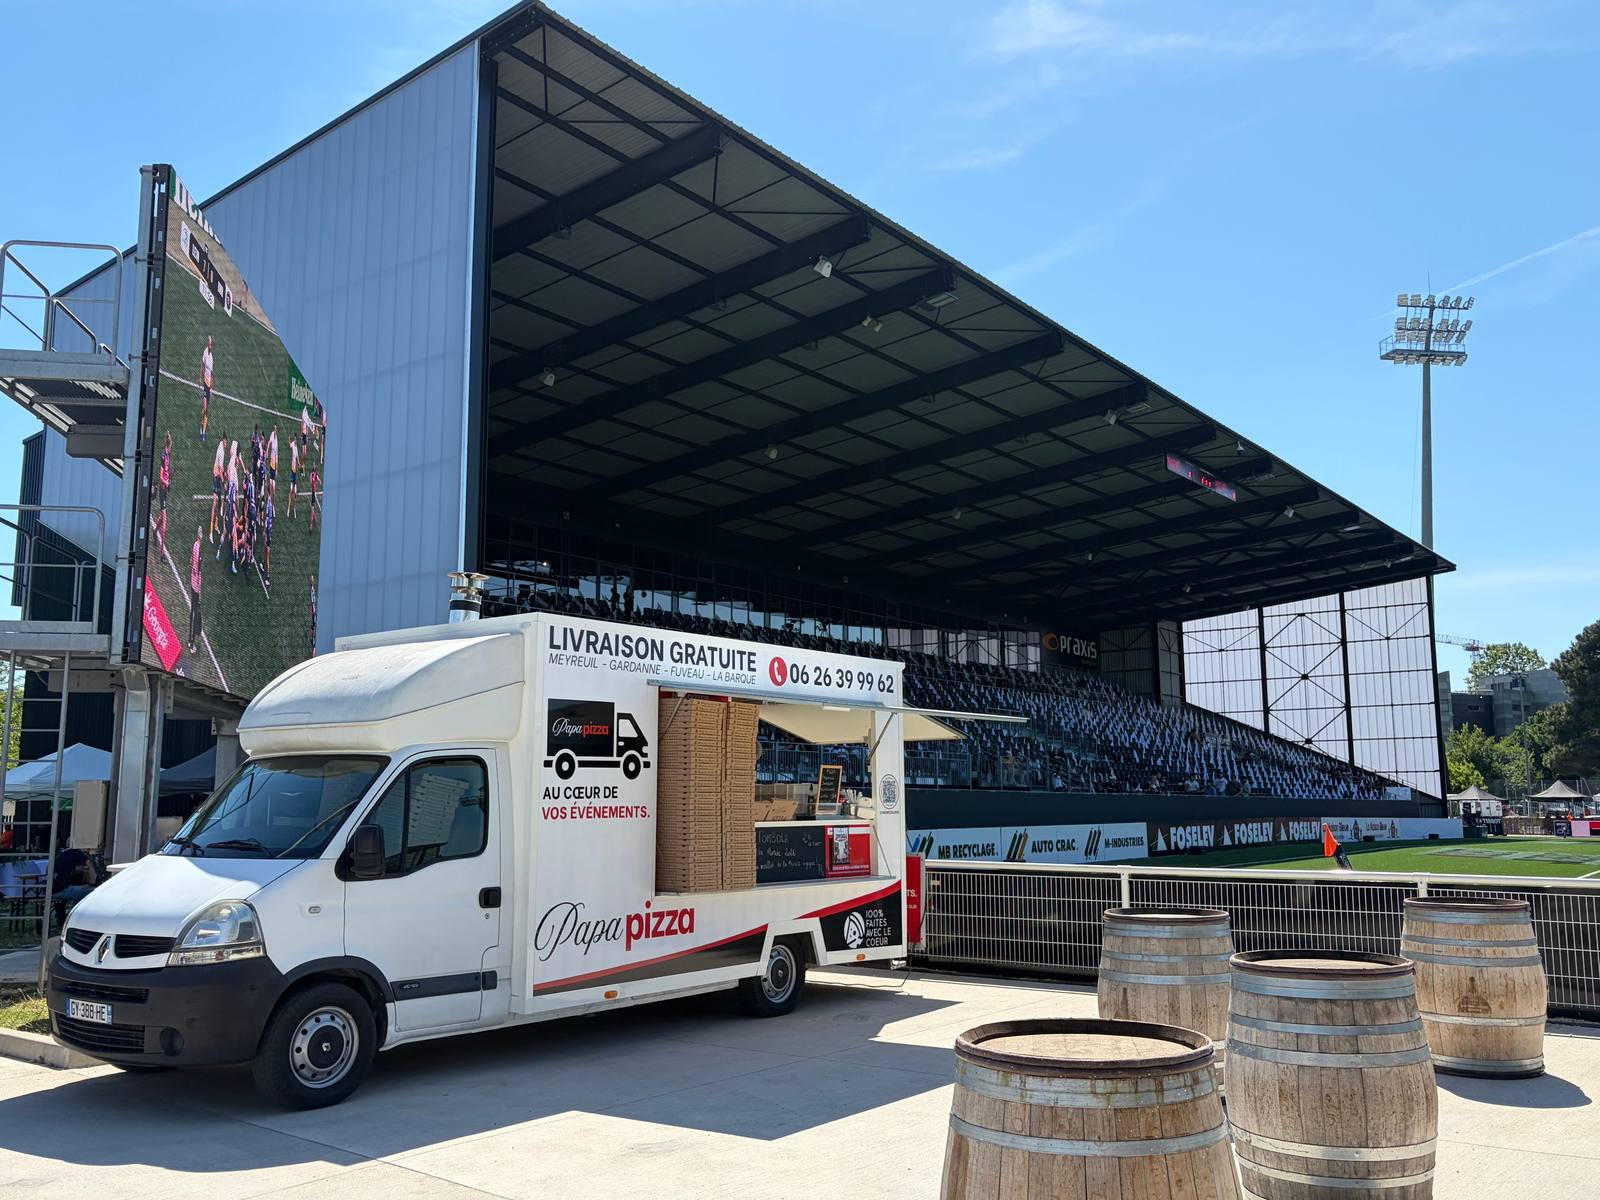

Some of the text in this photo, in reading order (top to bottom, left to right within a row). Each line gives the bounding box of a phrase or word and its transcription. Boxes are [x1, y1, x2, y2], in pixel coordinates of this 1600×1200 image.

[549, 625, 757, 673] LIVRAISON GRATUITE
[1060, 635, 1097, 659] praxis
[548, 652, 598, 669] MEYREUIL
[609, 659, 661, 675] GARDANNE
[670, 665, 704, 680] FUVEAU
[712, 672, 723, 682] LA
[724, 673, 756, 685] BARQUE
[790, 663, 895, 694] 06 26 39 99 62
[552, 717, 609, 738] Papa pizza
[543, 786, 618, 800] AU CŒUR DE
[542, 801, 651, 820] VOS ÉVÉNEMENTS.
[1169, 825, 1215, 850] FOSELEV
[1234, 822, 1273, 844] FOSELEV
[1288, 821, 1321, 840] FOSELEV
[1031, 840, 1053, 854] AUTO
[1104, 836, 1144, 849] M-INDUSTRIES
[938, 845, 951, 860] MB
[865, 909, 884, 919] 100%
[865, 918, 888, 929] FAITES
[534, 900, 695, 962] Papa pizza
[865, 927, 892, 938] AVEC LE
[865, 938, 889, 947] COEUR
